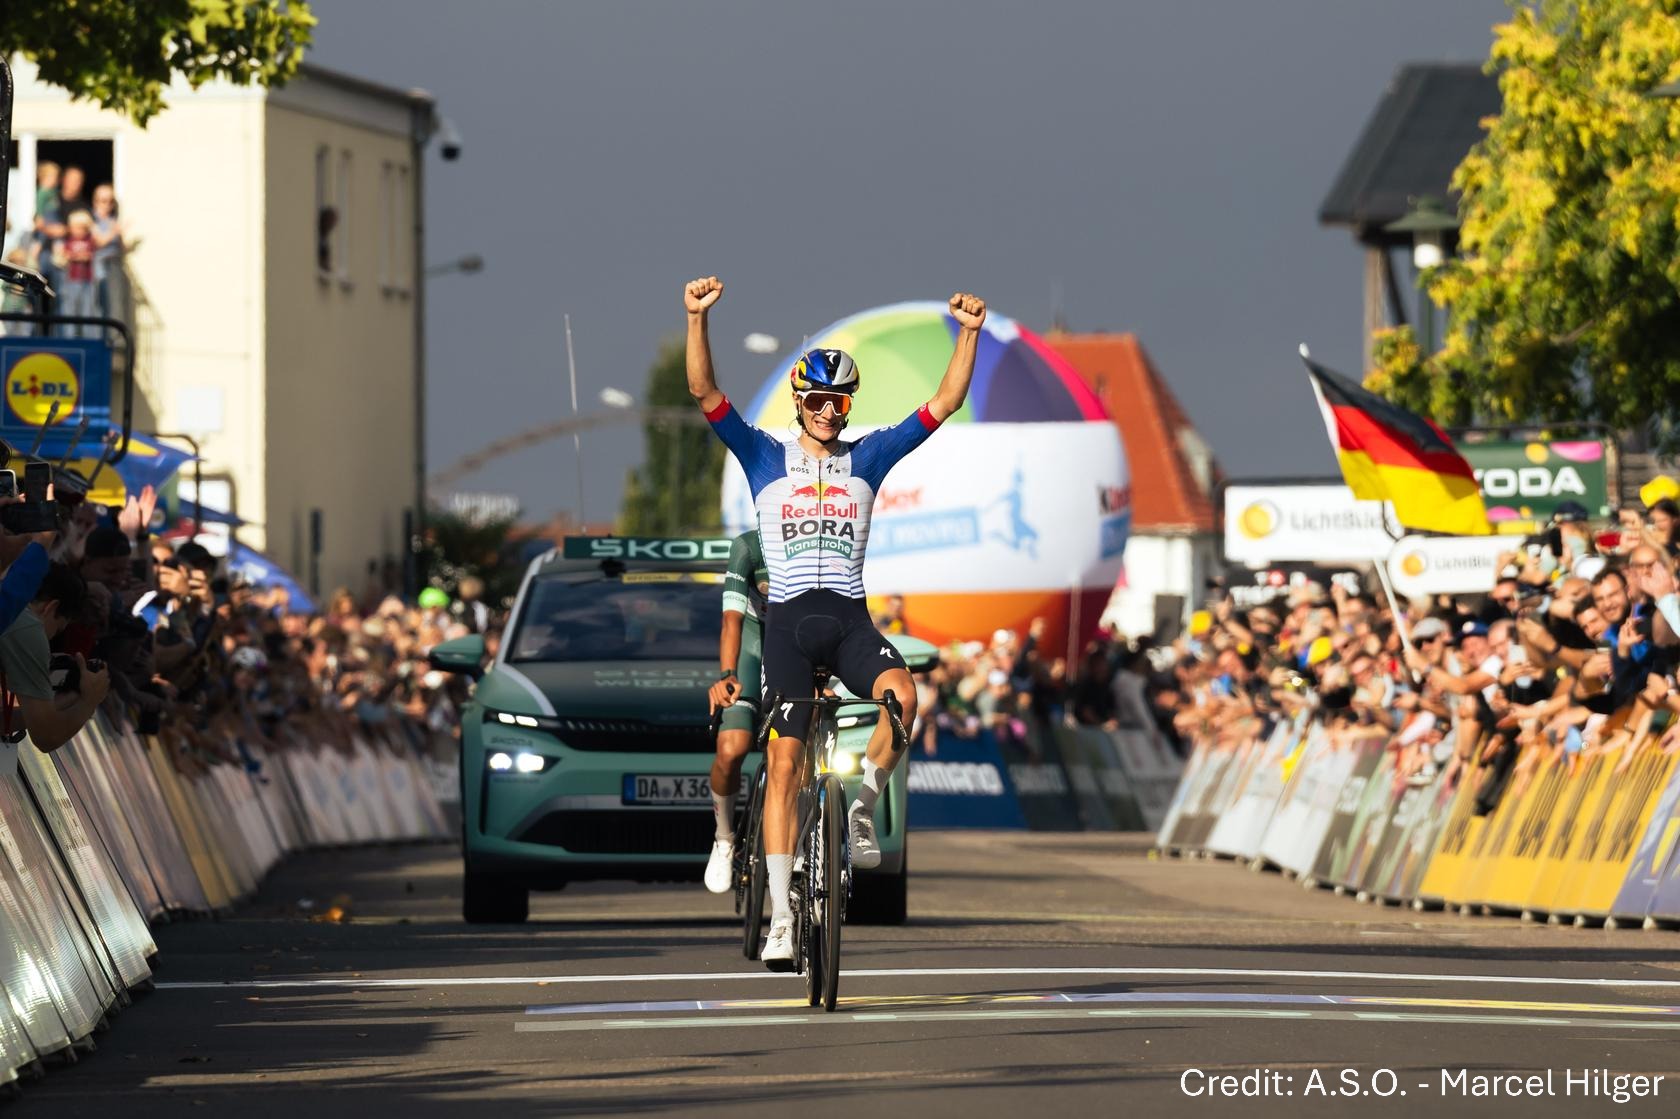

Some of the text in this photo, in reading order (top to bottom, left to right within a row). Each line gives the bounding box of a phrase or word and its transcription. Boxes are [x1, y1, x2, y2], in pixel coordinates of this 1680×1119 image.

[782, 503, 857, 519] Red Bull
[782, 520, 855, 541] BORA
[590, 539, 733, 559] ŠKOD
[787, 540, 851, 554] hansgrohe
[638, 778, 660, 797] DA
[673, 778, 685, 797] X
